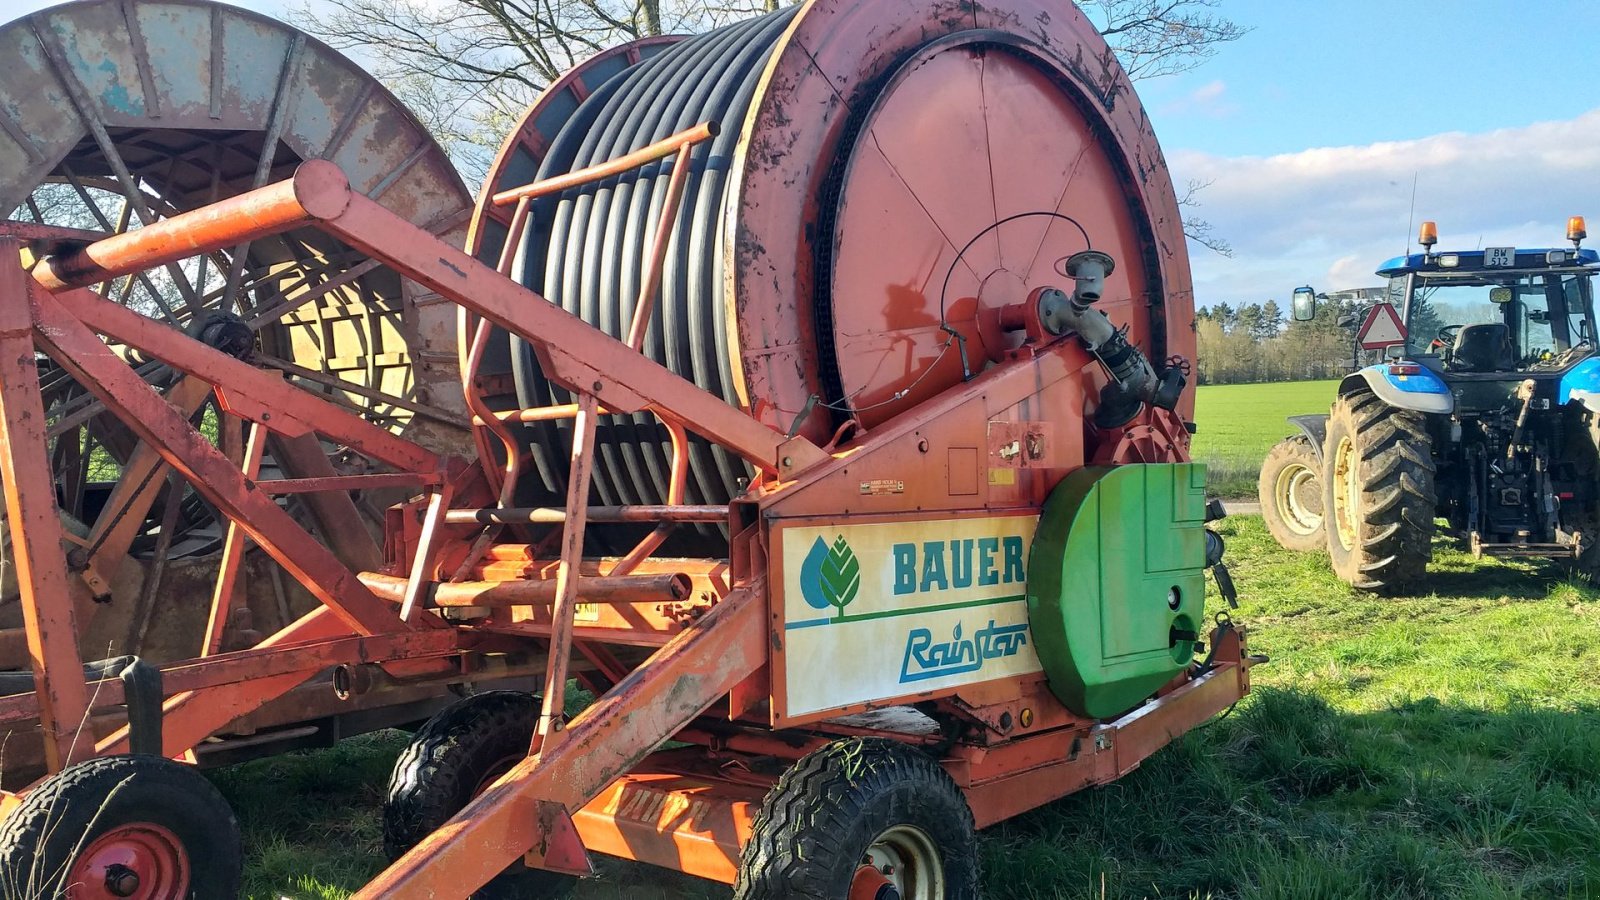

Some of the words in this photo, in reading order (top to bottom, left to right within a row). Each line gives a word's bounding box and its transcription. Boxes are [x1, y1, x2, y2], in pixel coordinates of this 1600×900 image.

[1493, 249, 1507, 257] BW
[1491, 257, 1508, 265] 512
[893, 535, 1025, 595] BAUER
